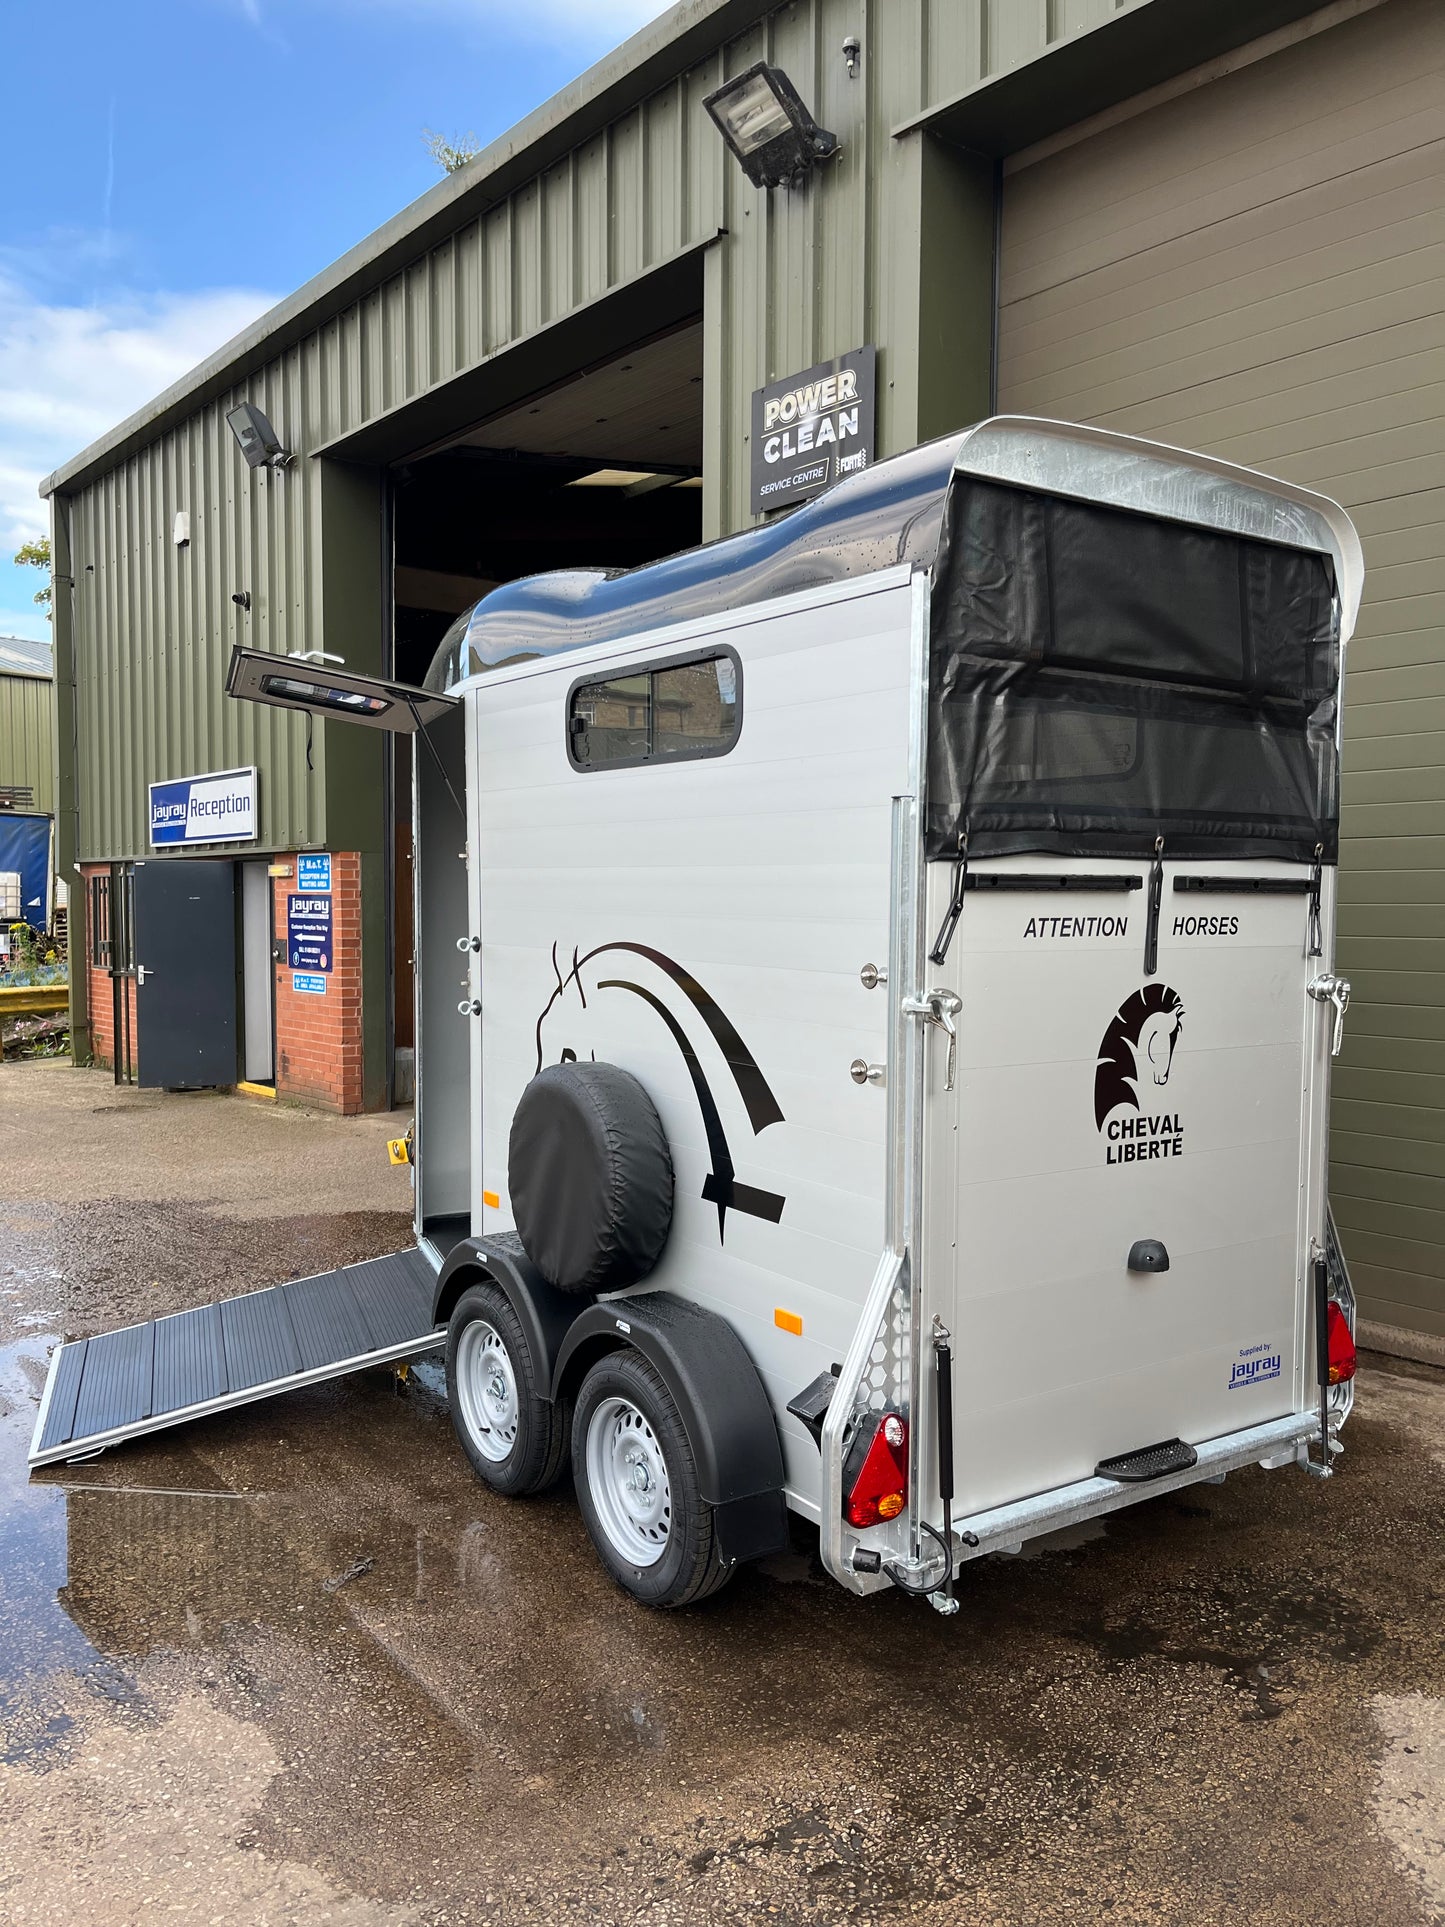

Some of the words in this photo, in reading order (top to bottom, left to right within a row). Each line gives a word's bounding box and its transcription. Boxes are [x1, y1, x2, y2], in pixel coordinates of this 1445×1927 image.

[764, 369, 858, 431] POWER
[764, 407, 858, 464] CLEAN
[760, 476, 791, 496] SERVICE
[792, 466, 824, 486] CENTRE
[152, 803, 186, 822] jayray
[190, 793, 250, 819] Reception
[290, 898, 329, 914] jayray
[1023, 916, 1128, 938] ATTENTION
[1172, 916, 1239, 936] HORSES
[1107, 1113, 1183, 1141] CHEVAL
[1106, 1133, 1183, 1165] LIBERTÉ
[1239, 1344, 1263, 1357] Supplied
[1229, 1355, 1281, 1383] jayray
